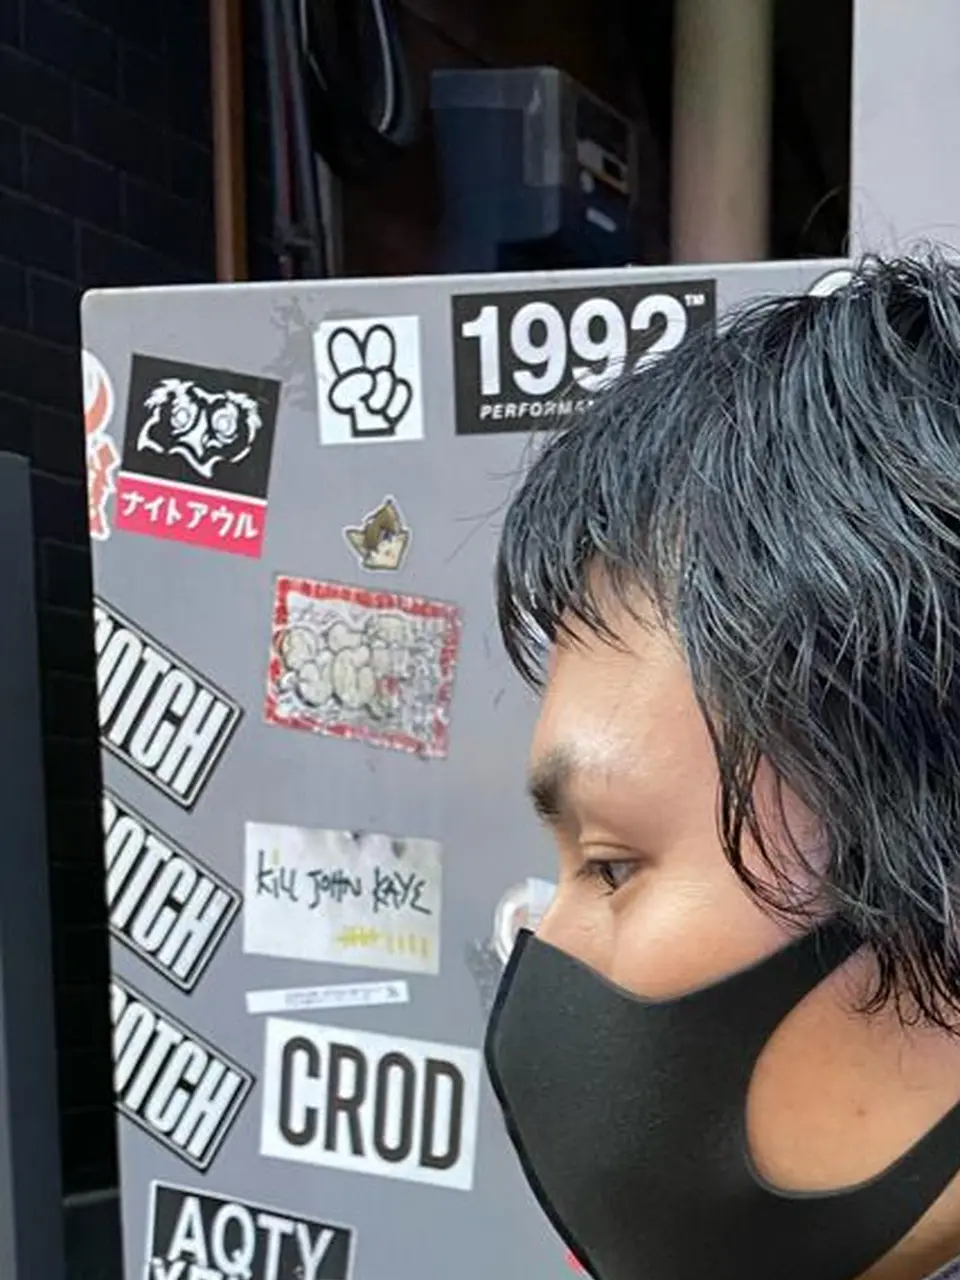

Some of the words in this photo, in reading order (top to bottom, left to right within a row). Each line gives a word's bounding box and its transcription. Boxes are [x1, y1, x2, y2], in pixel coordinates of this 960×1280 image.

[462, 294, 687, 396] 1992
[120, 491, 259, 538] ナイトアウル
[104, 799, 233, 979] OTCH
[111, 983, 244, 1160] OTCH
[278, 1036, 465, 1171] CROD
